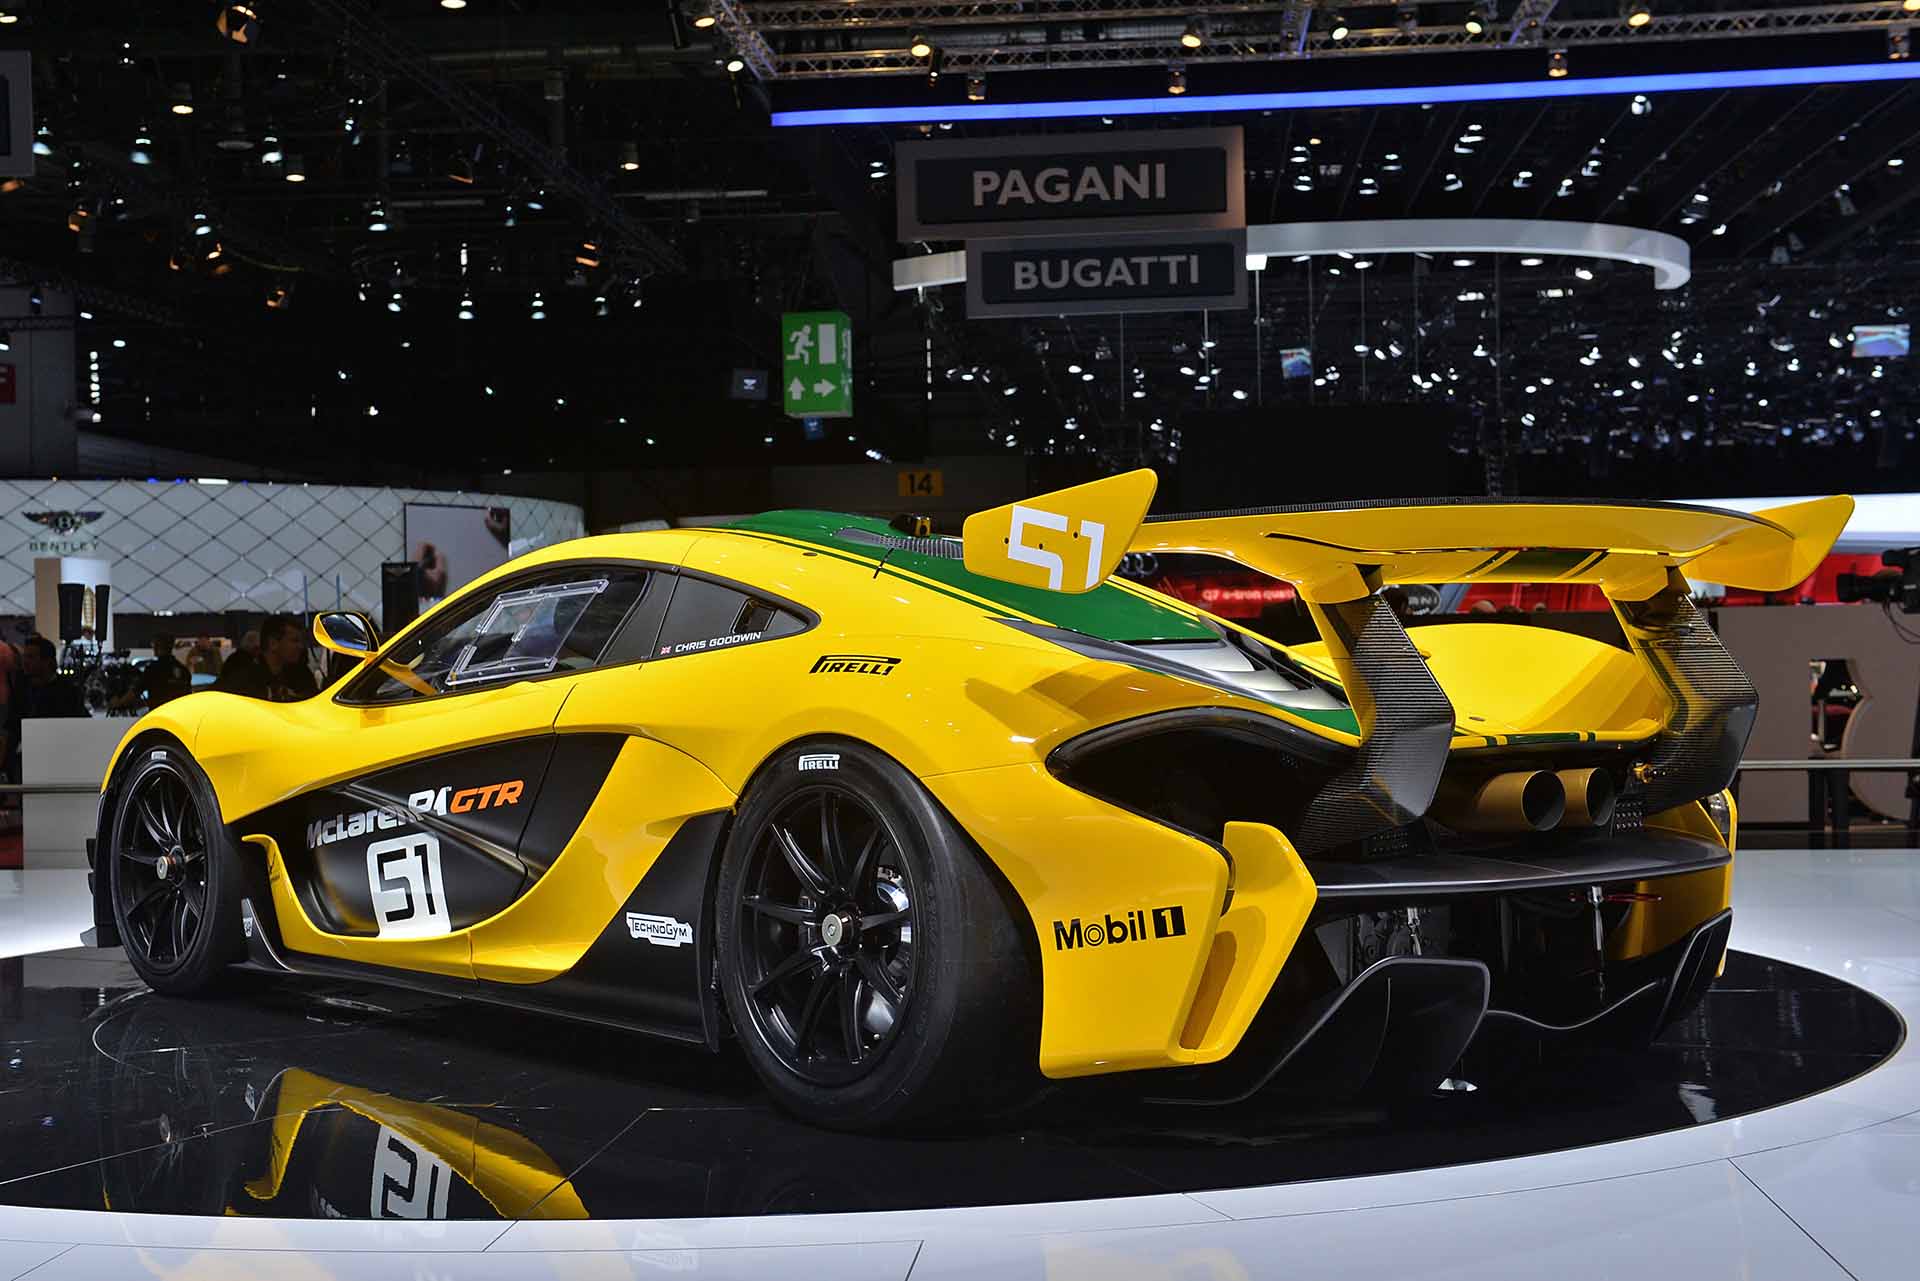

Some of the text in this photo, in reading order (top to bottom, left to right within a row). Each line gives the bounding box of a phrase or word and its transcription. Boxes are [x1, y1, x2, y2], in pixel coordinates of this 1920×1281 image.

[972, 163, 1166, 207] PAGANI
[1013, 254, 1199, 290] BUGATTI
[909, 473, 934, 495] 14
[29, 541, 98, 553] BENTLEY
[1008, 504, 1105, 591] 51
[675, 631, 762, 653] CHRIS GOODWIN
[809, 654, 902, 676] PIRELLI
[798, 753, 841, 771] PIRELLI
[450, 780, 525, 814] GTR
[376, 844, 436, 922] 51
[1053, 910, 1147, 951] Mobil
